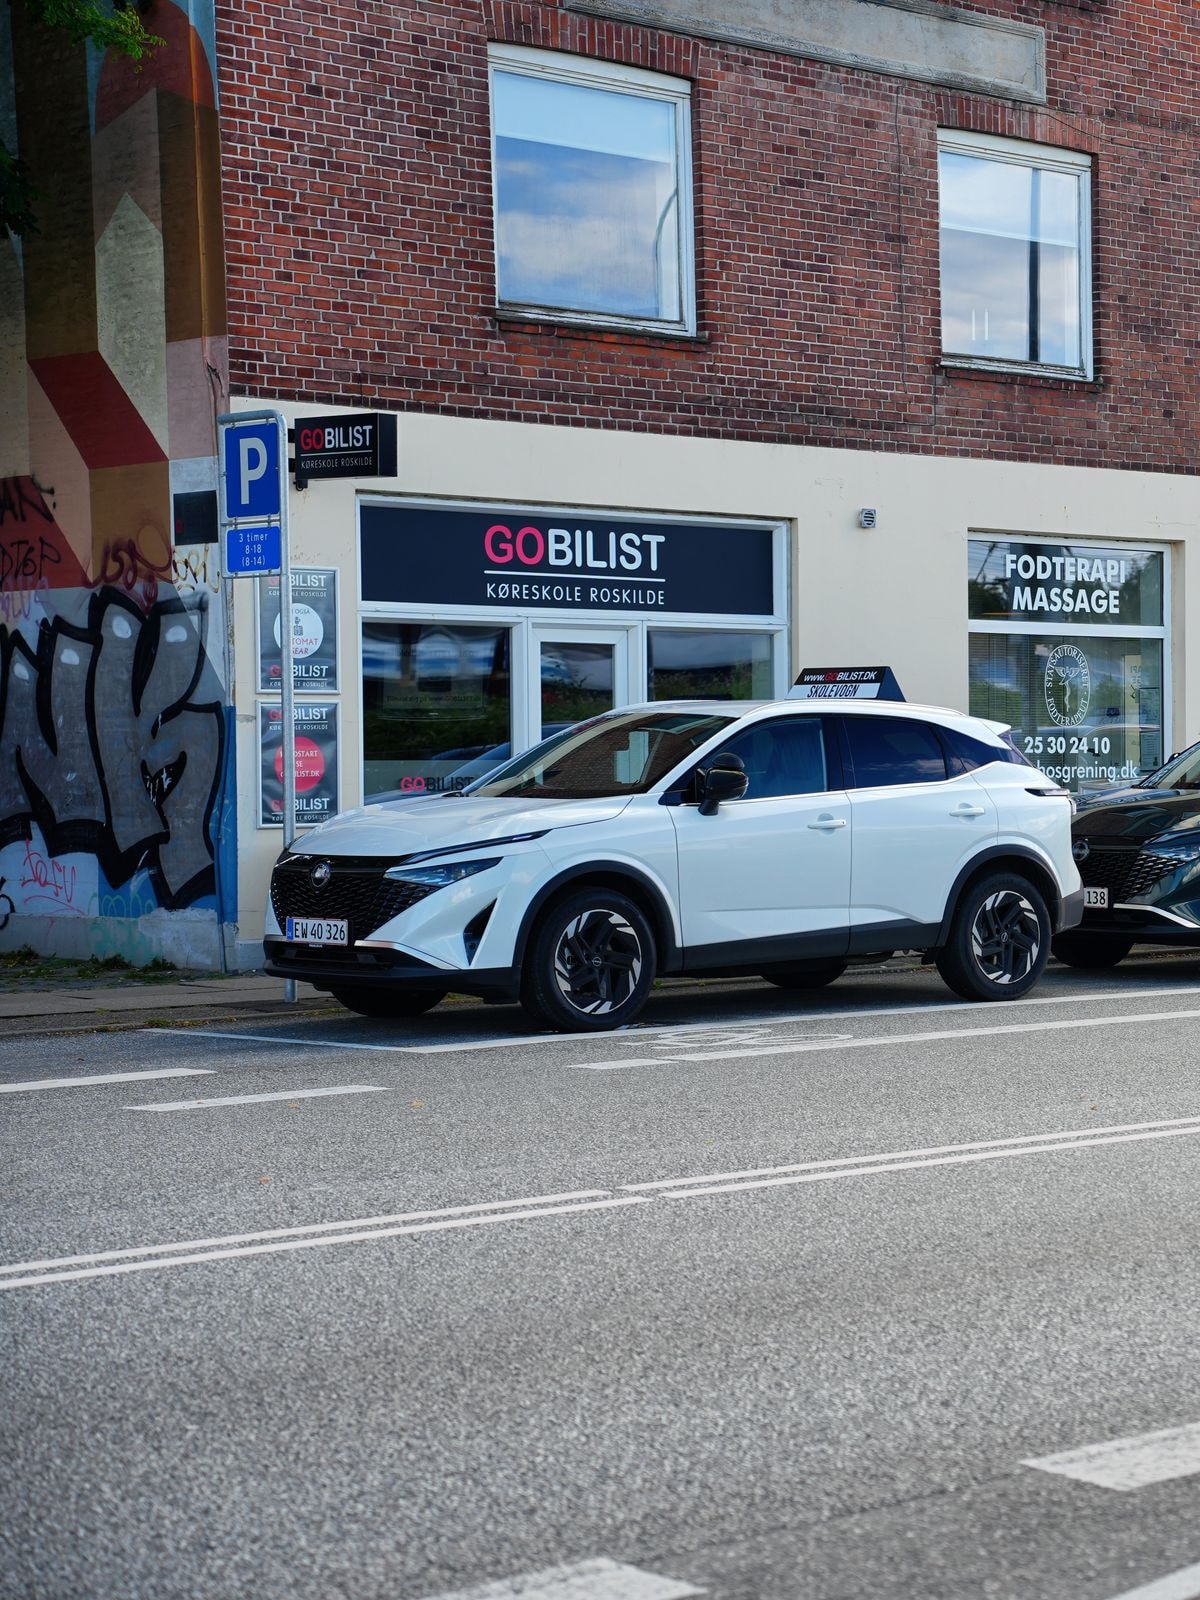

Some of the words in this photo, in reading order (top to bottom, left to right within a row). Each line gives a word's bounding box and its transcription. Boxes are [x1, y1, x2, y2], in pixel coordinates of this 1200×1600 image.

[301, 425, 373, 450] GOBILIST
[301, 458, 338, 470] KØRESKOLE
[340, 456, 373, 467] ROSKILDE
[239, 437, 268, 505] P
[239, 533, 244, 542] 3
[246, 532, 268, 542] timer
[244, 544, 262, 554] 8-18
[483, 524, 666, 572] GOBILIST
[241, 556, 266, 567] (8-14)
[1005, 554, 1126, 583] FODTERAPI
[268, 575, 327, 587] GBILIST
[486, 582, 582, 602] KØRESKOLE
[590, 587, 665, 606] ROSKILDE
[1012, 586, 1120, 614] MASSAGE
[292, 638, 319, 646] TOMAT
[269, 665, 329, 677] GBILIST
[804, 671, 878, 682] www.GOBILIST.DK
[807, 684, 860, 698] SKOLEVOGN
[268, 708, 328, 721] GBILIST
[1024, 736, 1043, 754] 25
[1046, 736, 1066, 754] 30
[1069, 736, 1088, 754] 24
[1092, 737, 1111, 754] 10
[400, 776, 475, 792] GOBILIST
[271, 798, 330, 812] GBILIST
[1086, 890, 1106, 905] 138
[294, 921, 308, 939] EW
[310, 922, 323, 940] 40
[326, 923, 346, 941] 326
